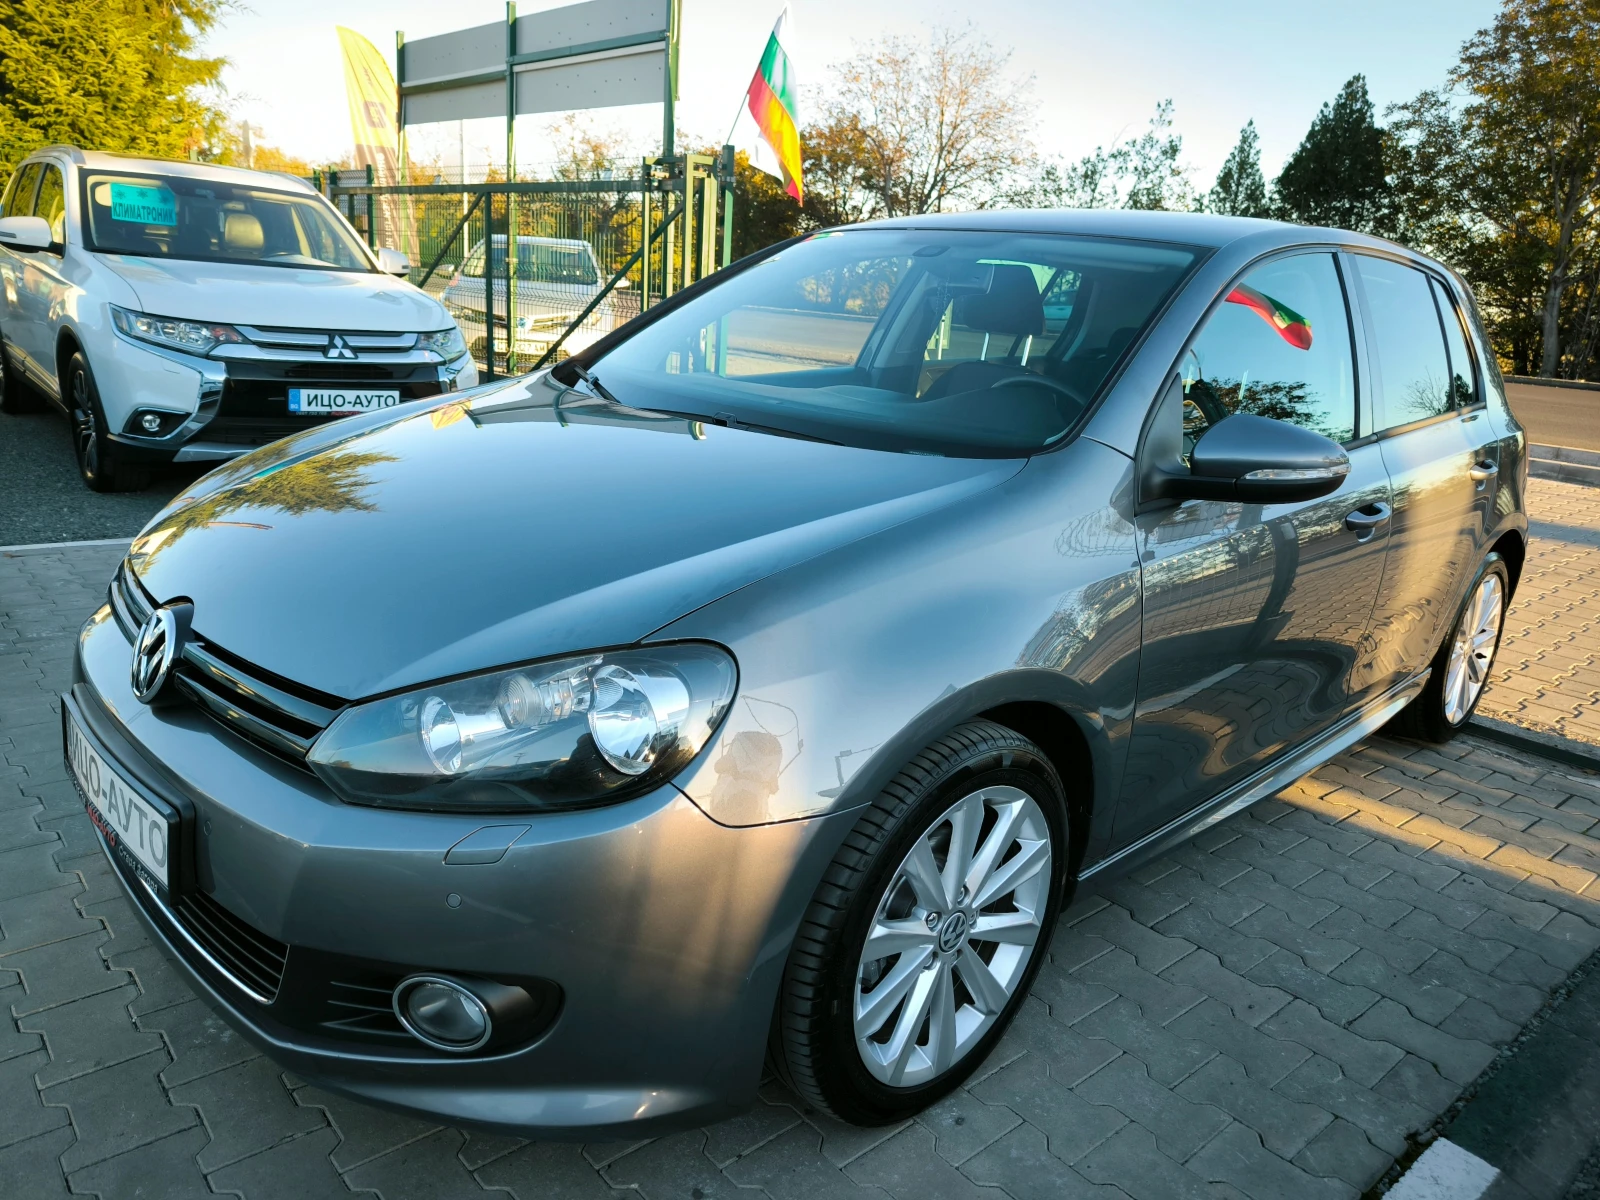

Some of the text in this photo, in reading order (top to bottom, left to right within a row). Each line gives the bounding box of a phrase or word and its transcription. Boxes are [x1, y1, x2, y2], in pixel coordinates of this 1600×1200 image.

[112, 201, 175, 223] КЛИМАТРОНИК
[307, 393, 396, 410] ИЦО-АУТО
[71, 724, 167, 869] ИЦО-АУТО
